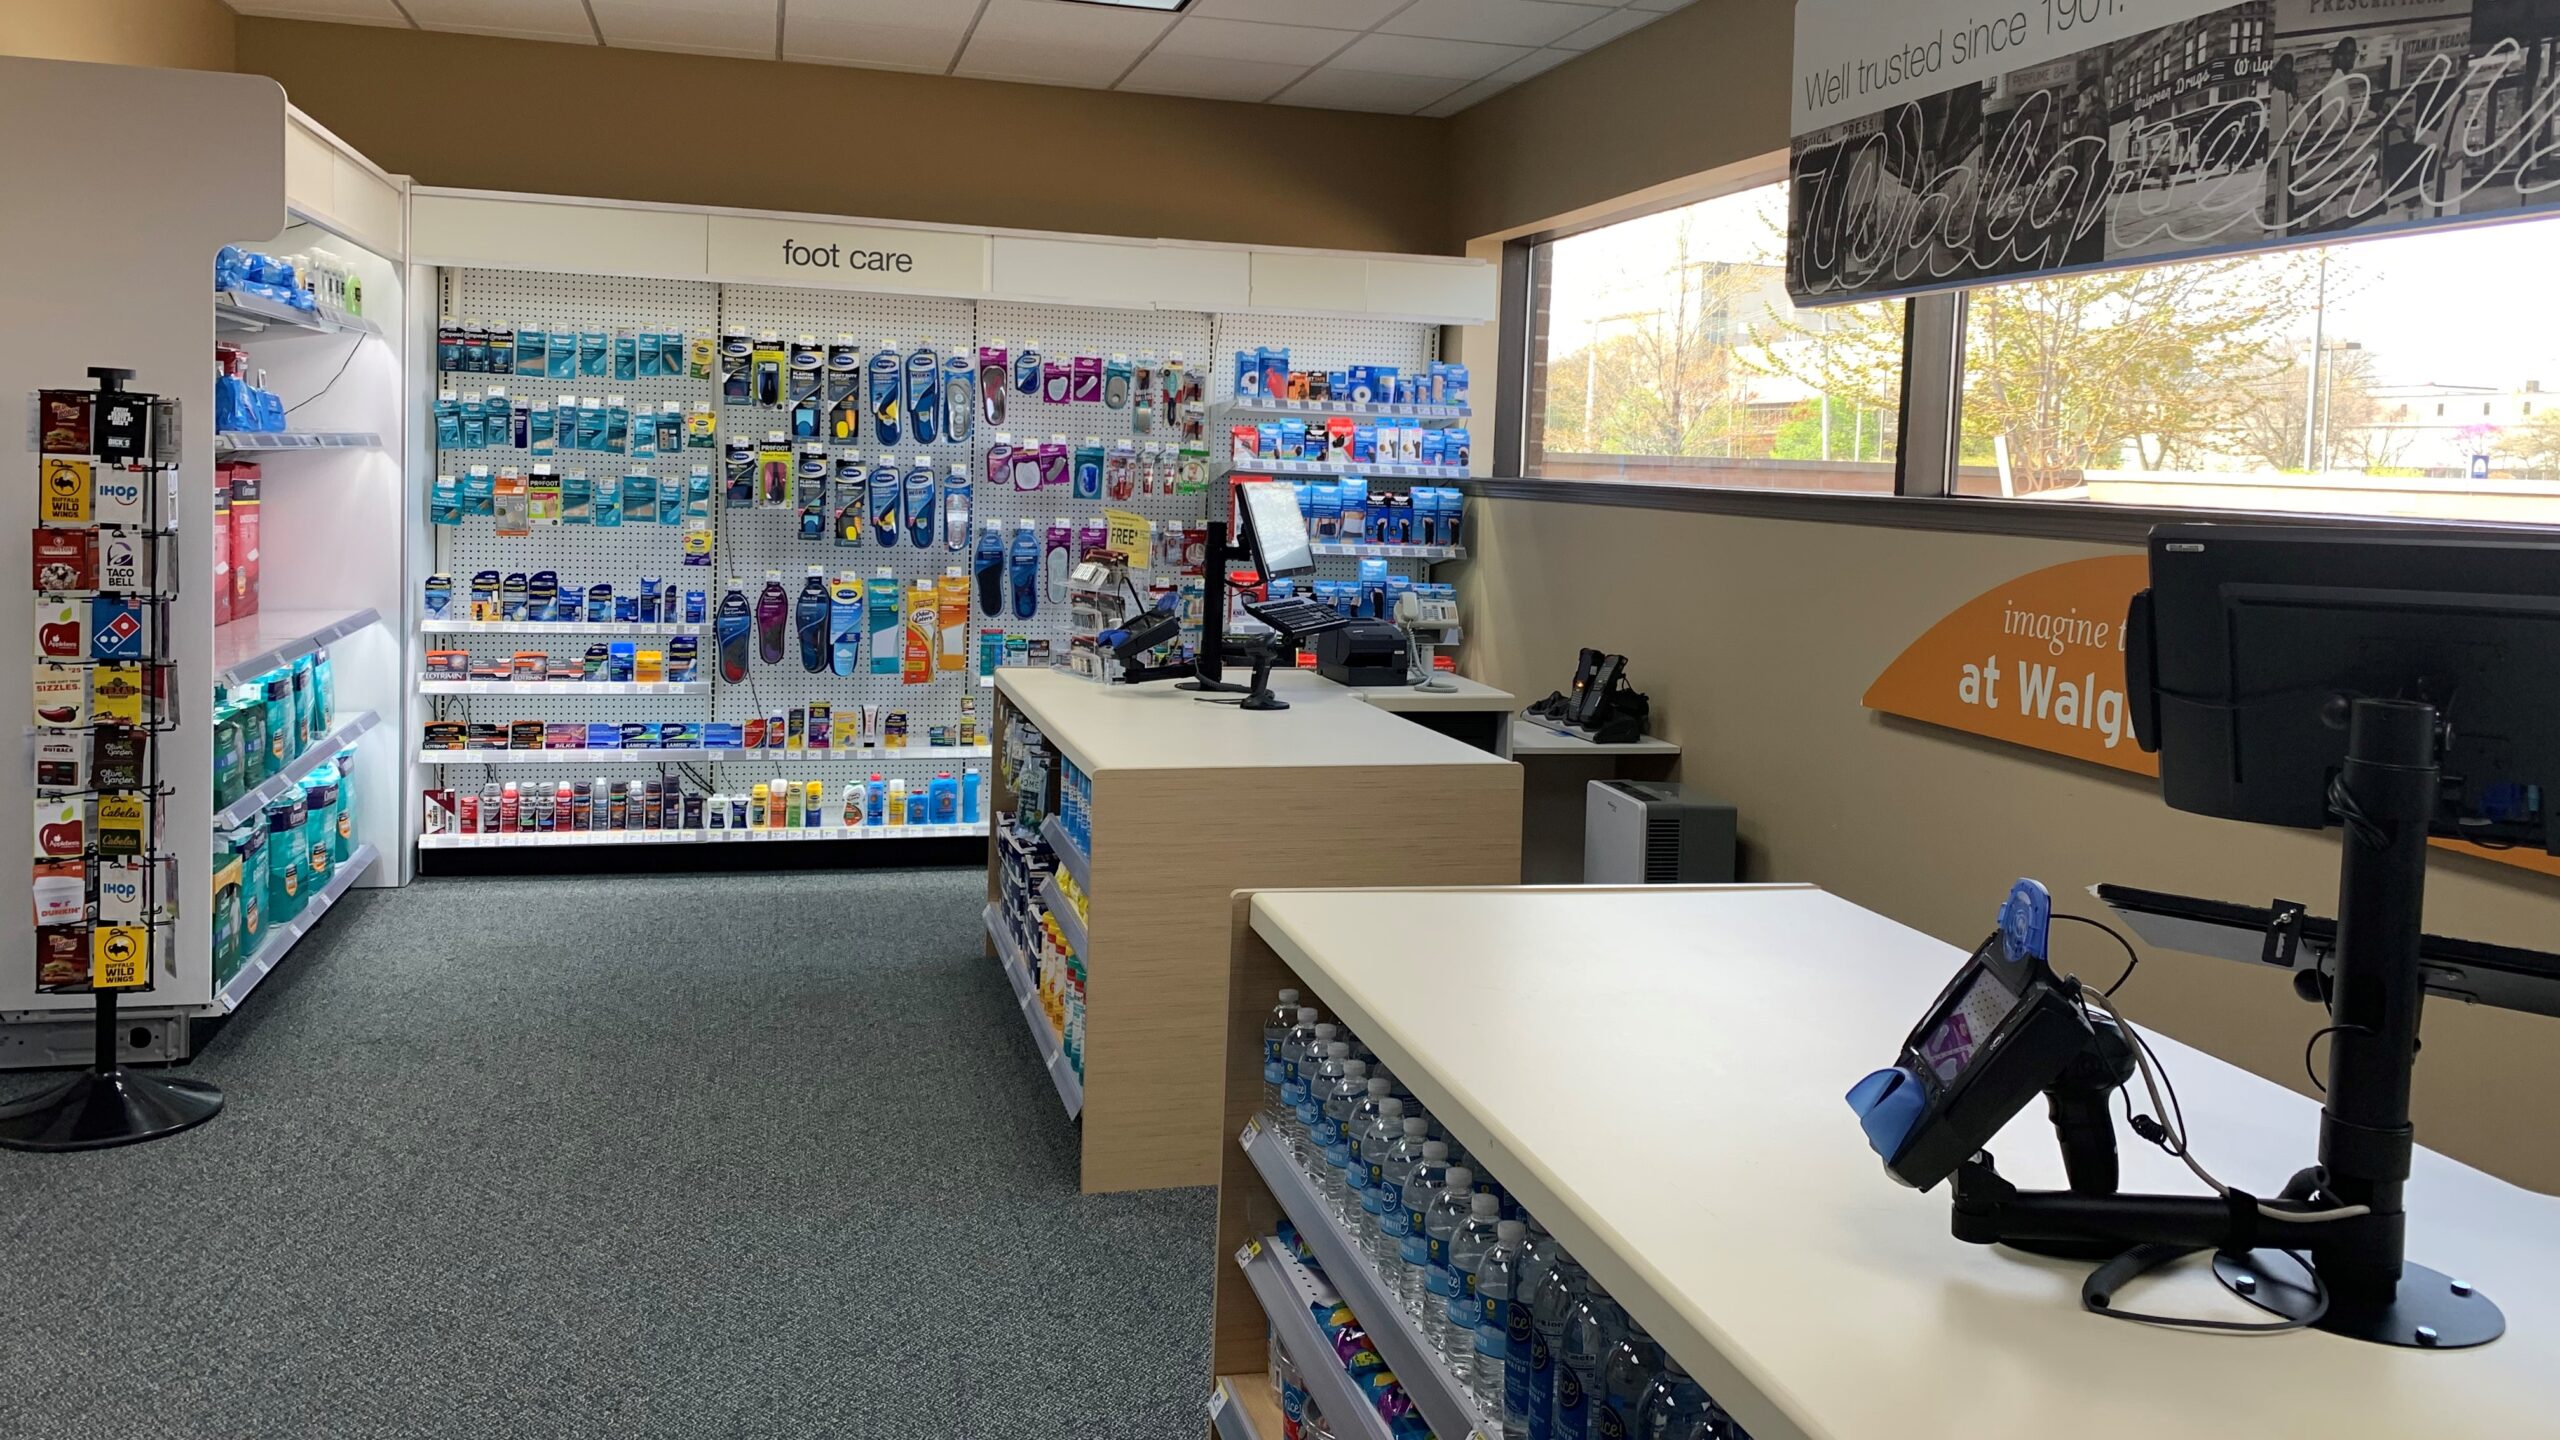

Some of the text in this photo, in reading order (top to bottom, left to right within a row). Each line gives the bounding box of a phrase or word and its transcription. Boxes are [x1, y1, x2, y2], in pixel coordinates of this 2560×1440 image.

[1804, 61, 1850, 112] Well
[1856, 29, 1943, 97] trusted
[1951, 11, 2028, 65] since
[2173, 69, 2211, 96] Drugs
[783, 239, 913, 272] foot care
[52, 503, 79, 512] WILD
[106, 568, 135, 577] TACO
[108, 577, 135, 587] BELL
[2004, 599, 2109, 656] imagine
[425, 672, 463, 680] LOTRIMIN
[1958, 655, 2000, 709] at
[36, 683, 81, 692] SIZZLES.
[102, 686, 135, 695] TEXAS
[100, 768, 123, 778] Olive
[103, 775, 135, 785] Garden
[106, 968, 134, 977] WILD
[106, 976, 134, 984] WINGS
